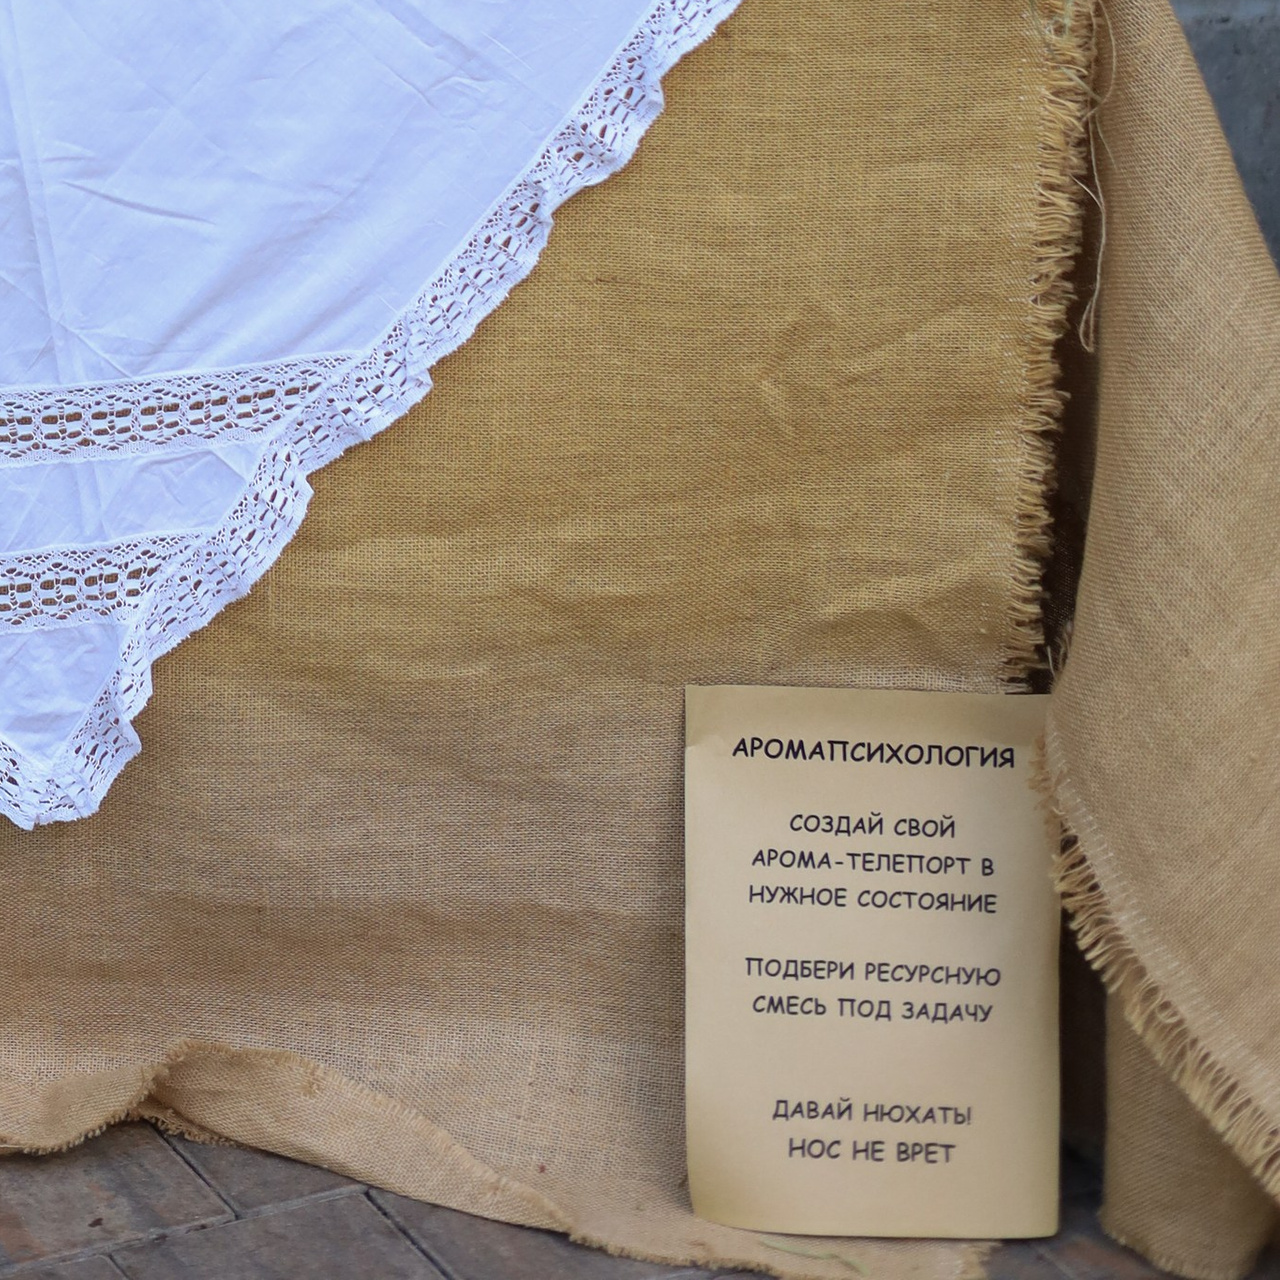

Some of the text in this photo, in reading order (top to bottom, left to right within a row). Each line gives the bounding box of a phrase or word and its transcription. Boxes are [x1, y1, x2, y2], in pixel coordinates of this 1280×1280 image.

[732, 738, 1015, 768] АРОМАПСИХОЛОГИЯ
[789, 811, 956, 838] СОЗДАЙ СВОЙ
[752, 850, 994, 876] АРОМА-ТЕЛЕПОРТ В
[749, 885, 998, 914] НУЖНОЕ СОСТОЯНИЕ
[745, 957, 1001, 987] ПОДБЕРИ РЕСУРСНУЮ
[753, 996, 993, 1023] СМЕСЬ ПОД ЗАДАЧУ
[773, 1098, 972, 1126] ДАВАЙ НЮХАТЬ!
[788, 1139, 956, 1163] НОС НЕ ВРЕТ
